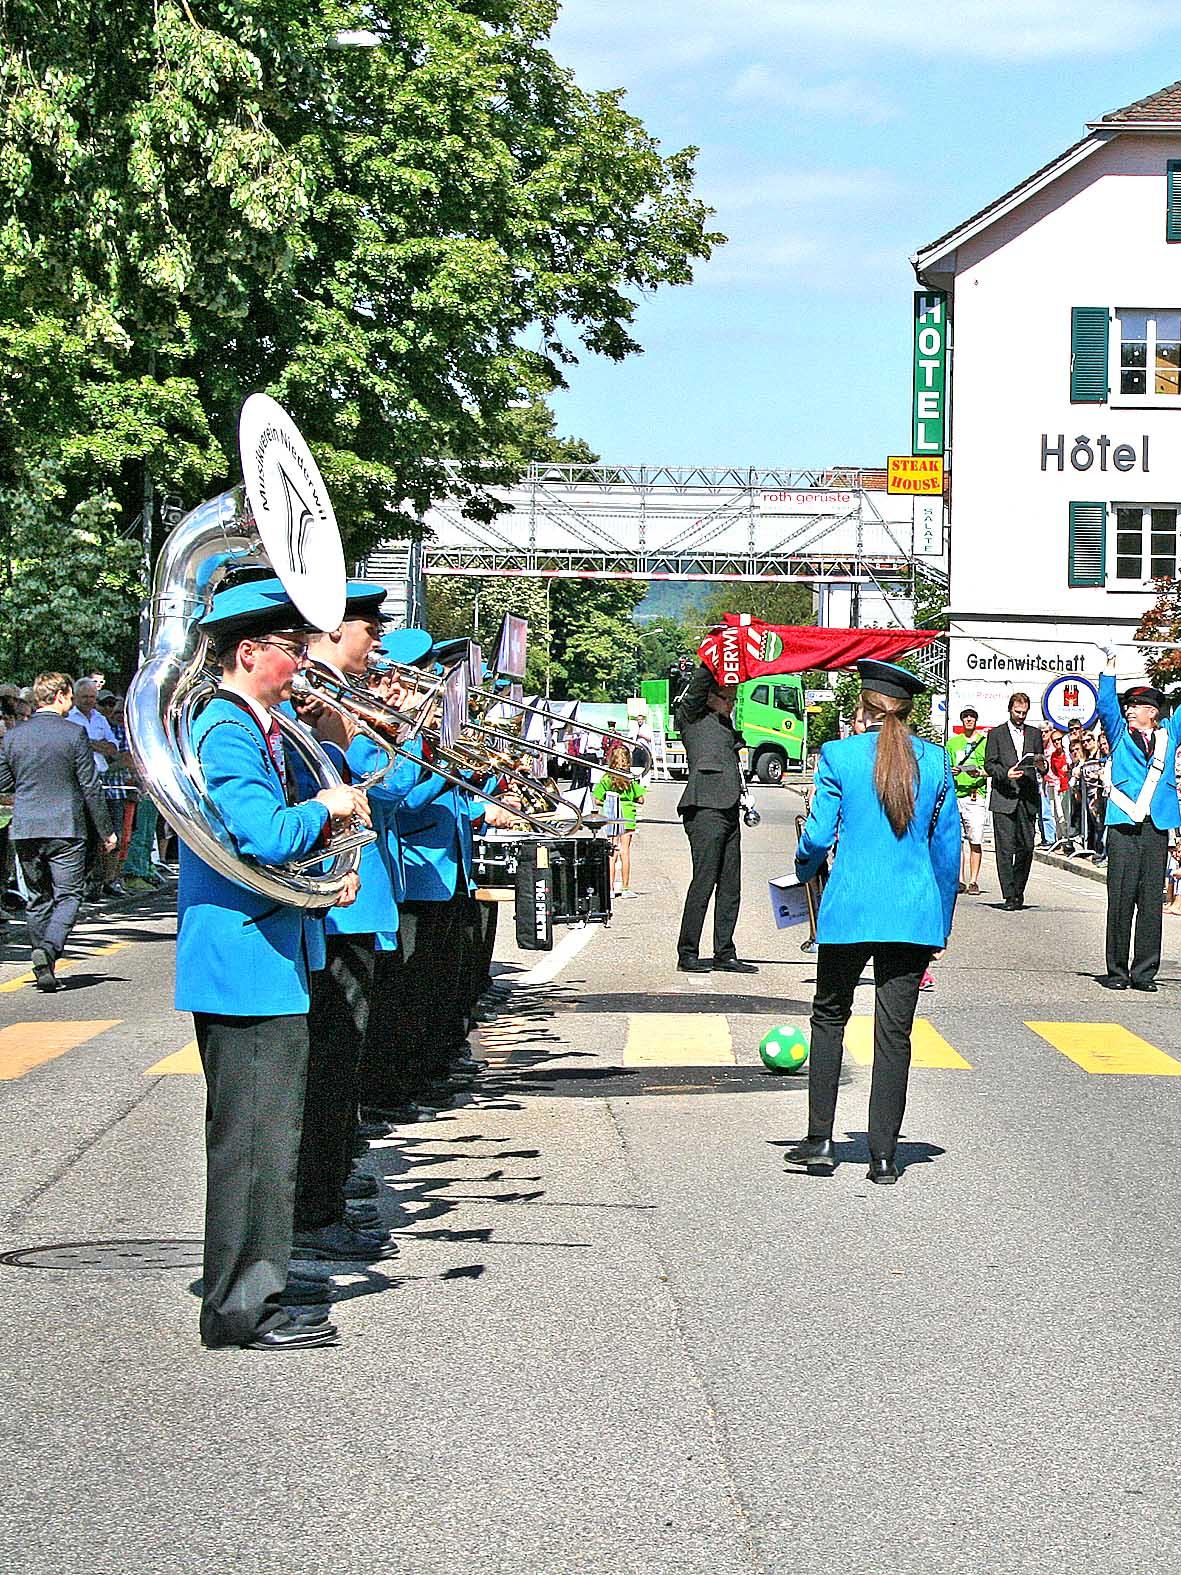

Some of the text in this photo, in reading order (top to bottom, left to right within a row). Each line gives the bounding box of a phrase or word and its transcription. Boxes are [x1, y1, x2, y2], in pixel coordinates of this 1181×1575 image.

[917, 297, 941, 450] HOTEL
[892, 460, 939, 472] STEAK
[1041, 434, 1150, 473] Hôtel
[255, 422, 328, 520] Musikverein Niederwil
[891, 476, 940, 491] HOUSE
[763, 491, 792, 502] roth
[924, 508, 933, 552] SALATE
[967, 653, 1085, 672] Gartenwirtschaft
